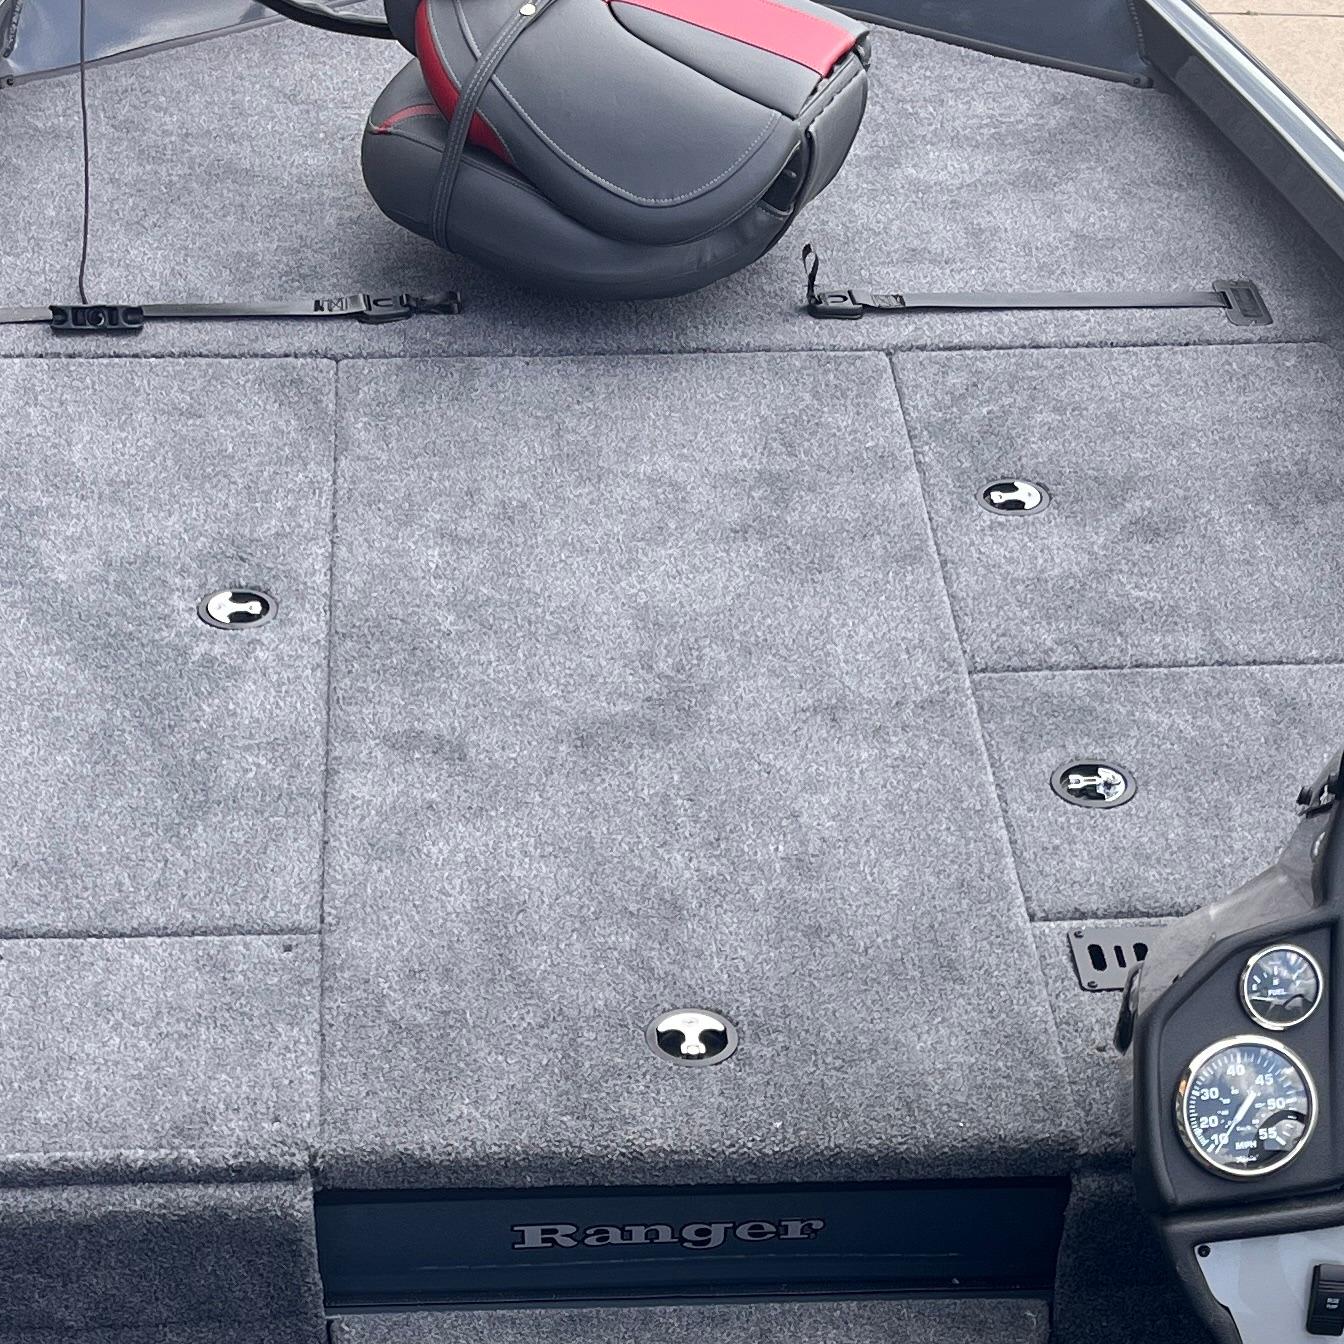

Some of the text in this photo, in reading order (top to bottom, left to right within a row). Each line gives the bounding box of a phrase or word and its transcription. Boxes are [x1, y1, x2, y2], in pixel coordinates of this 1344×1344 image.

[1226, 1063, 1246, 1077] 40
[1255, 1072, 1274, 1086] 45
[1200, 1087, 1220, 1101] 30
[1267, 1097, 1286, 1111] 50
[1199, 1115, 1219, 1129] 20
[1210, 1132, 1230, 1146] 10
[1258, 1126, 1278, 1140] 55
[1235, 1140, 1258, 1151] MPH
[512, 1217, 825, 1250] Ranger
